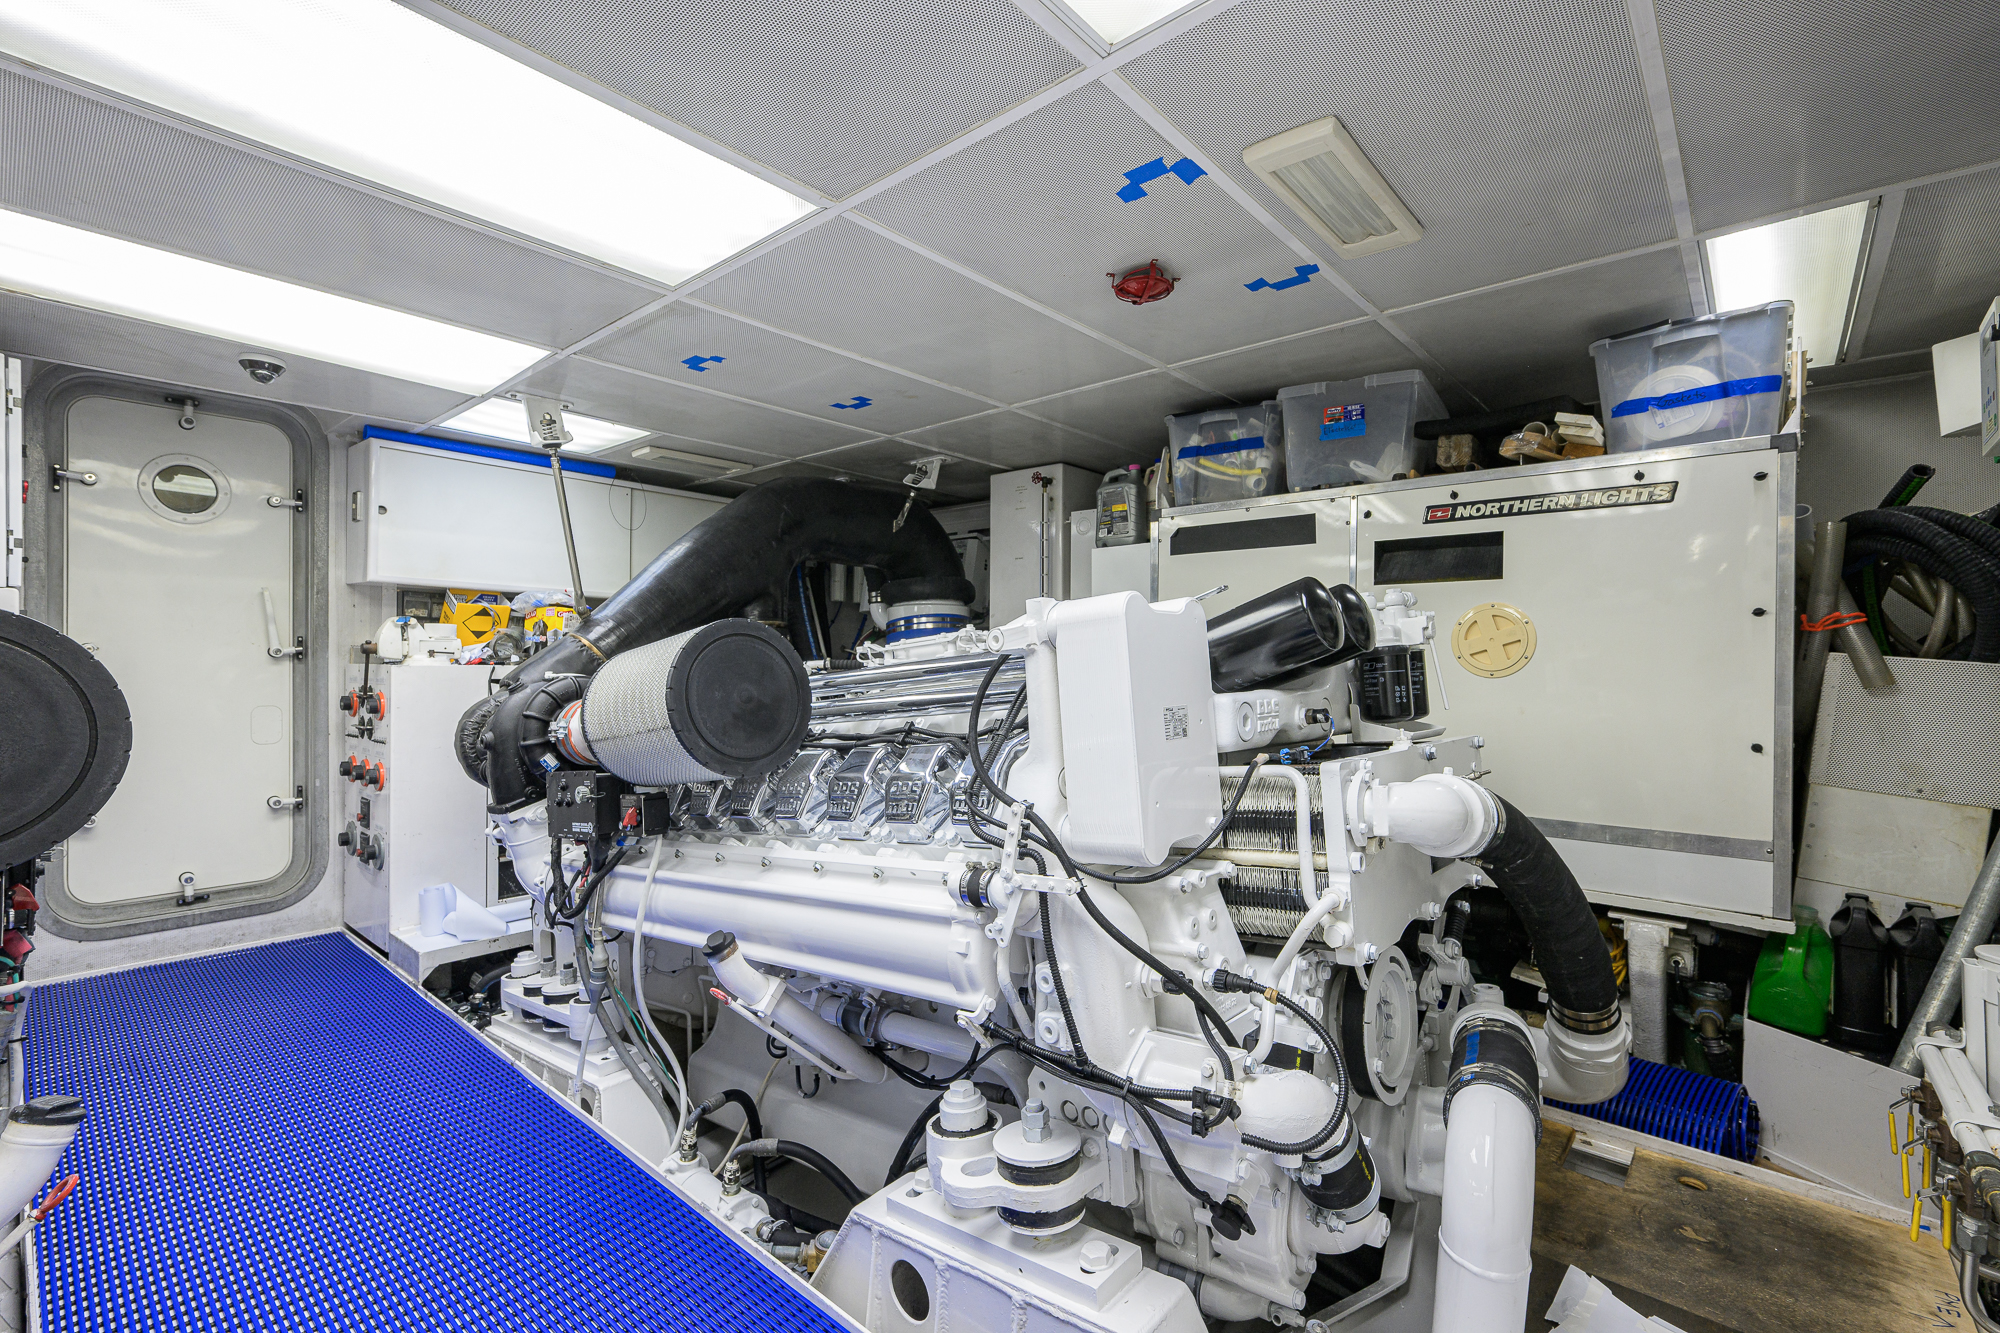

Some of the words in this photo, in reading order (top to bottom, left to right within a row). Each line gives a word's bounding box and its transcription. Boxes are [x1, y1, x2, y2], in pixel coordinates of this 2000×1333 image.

[1656, 390, 1707, 408] Gaskets
[1454, 493, 1576, 518] NORTHERN
[1579, 484, 1671, 508] LIGHTS
[1257, 717, 1280, 733] mtu
